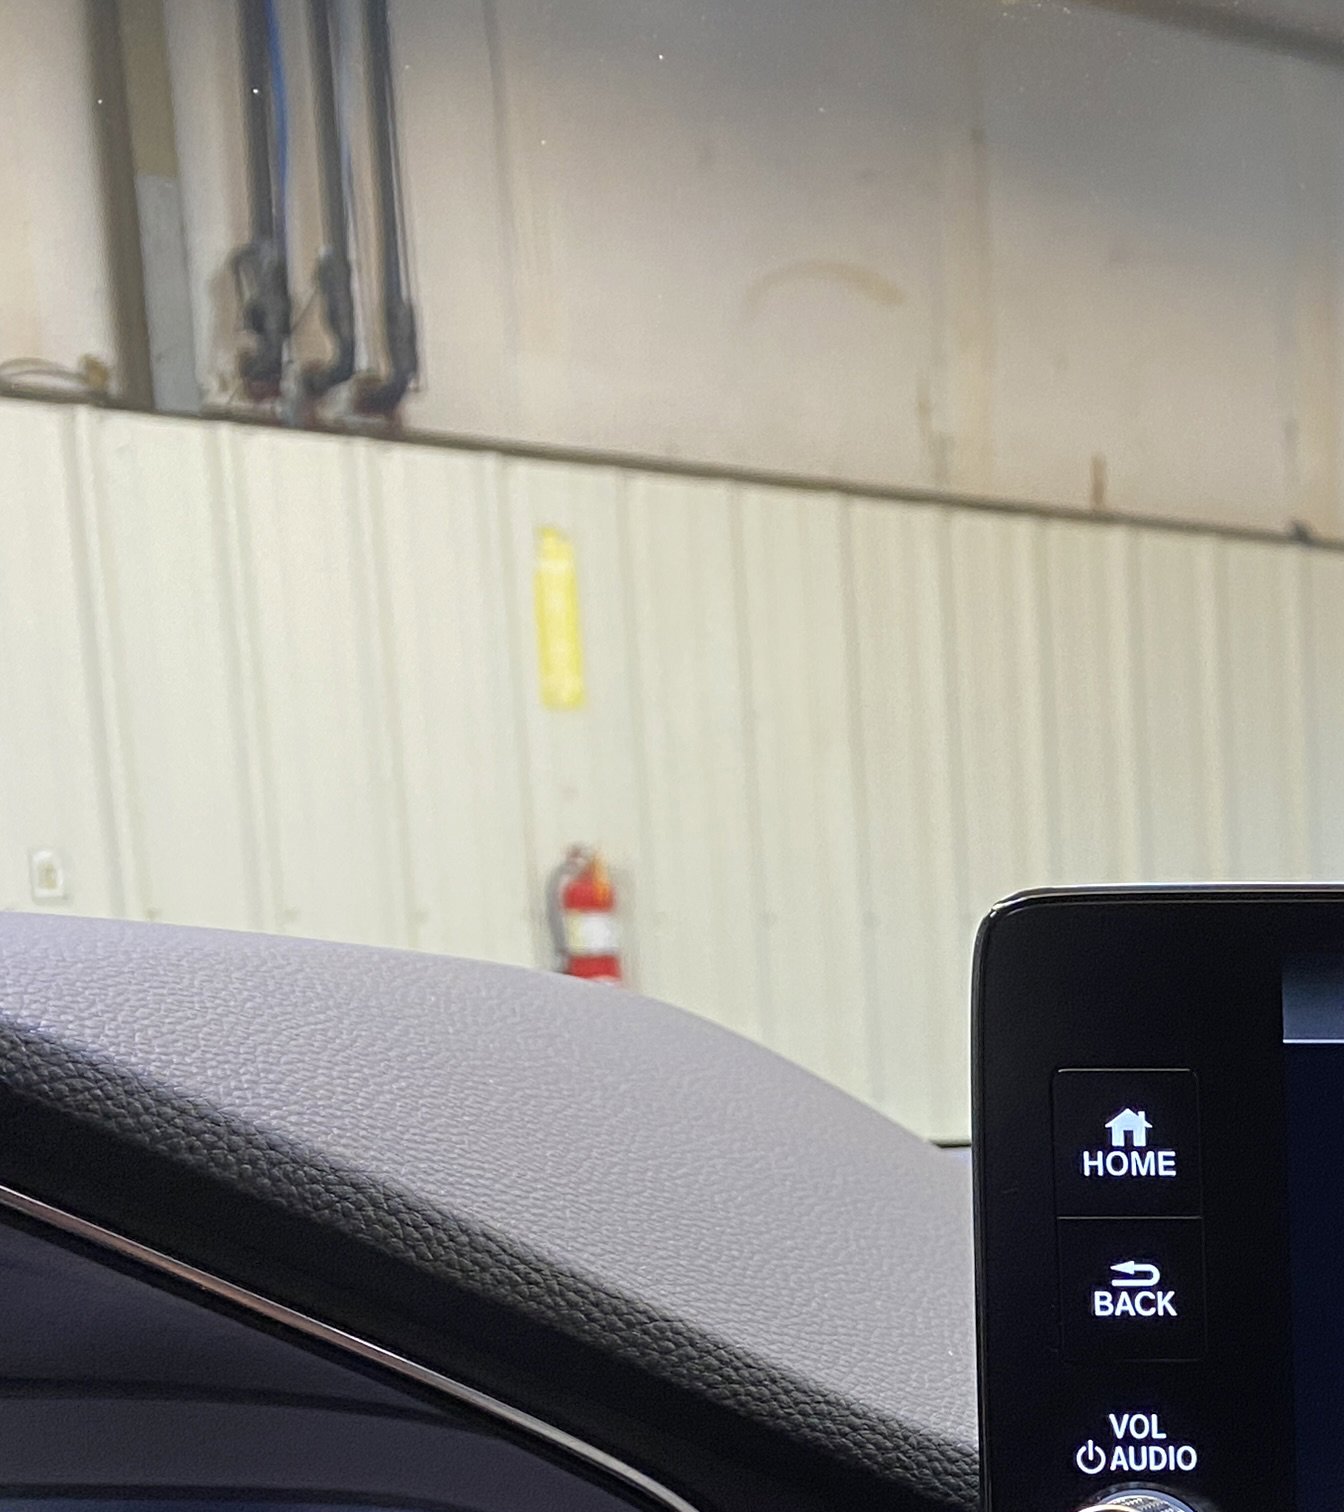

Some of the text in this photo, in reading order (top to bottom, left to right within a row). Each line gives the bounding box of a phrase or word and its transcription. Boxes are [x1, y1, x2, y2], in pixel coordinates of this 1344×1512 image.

[1082, 1150, 1177, 1177] HOME
[1094, 1290, 1178, 1317] BACK
[1108, 1413, 1167, 1440] VOL
[1109, 1445, 1198, 1472] AUDIO
